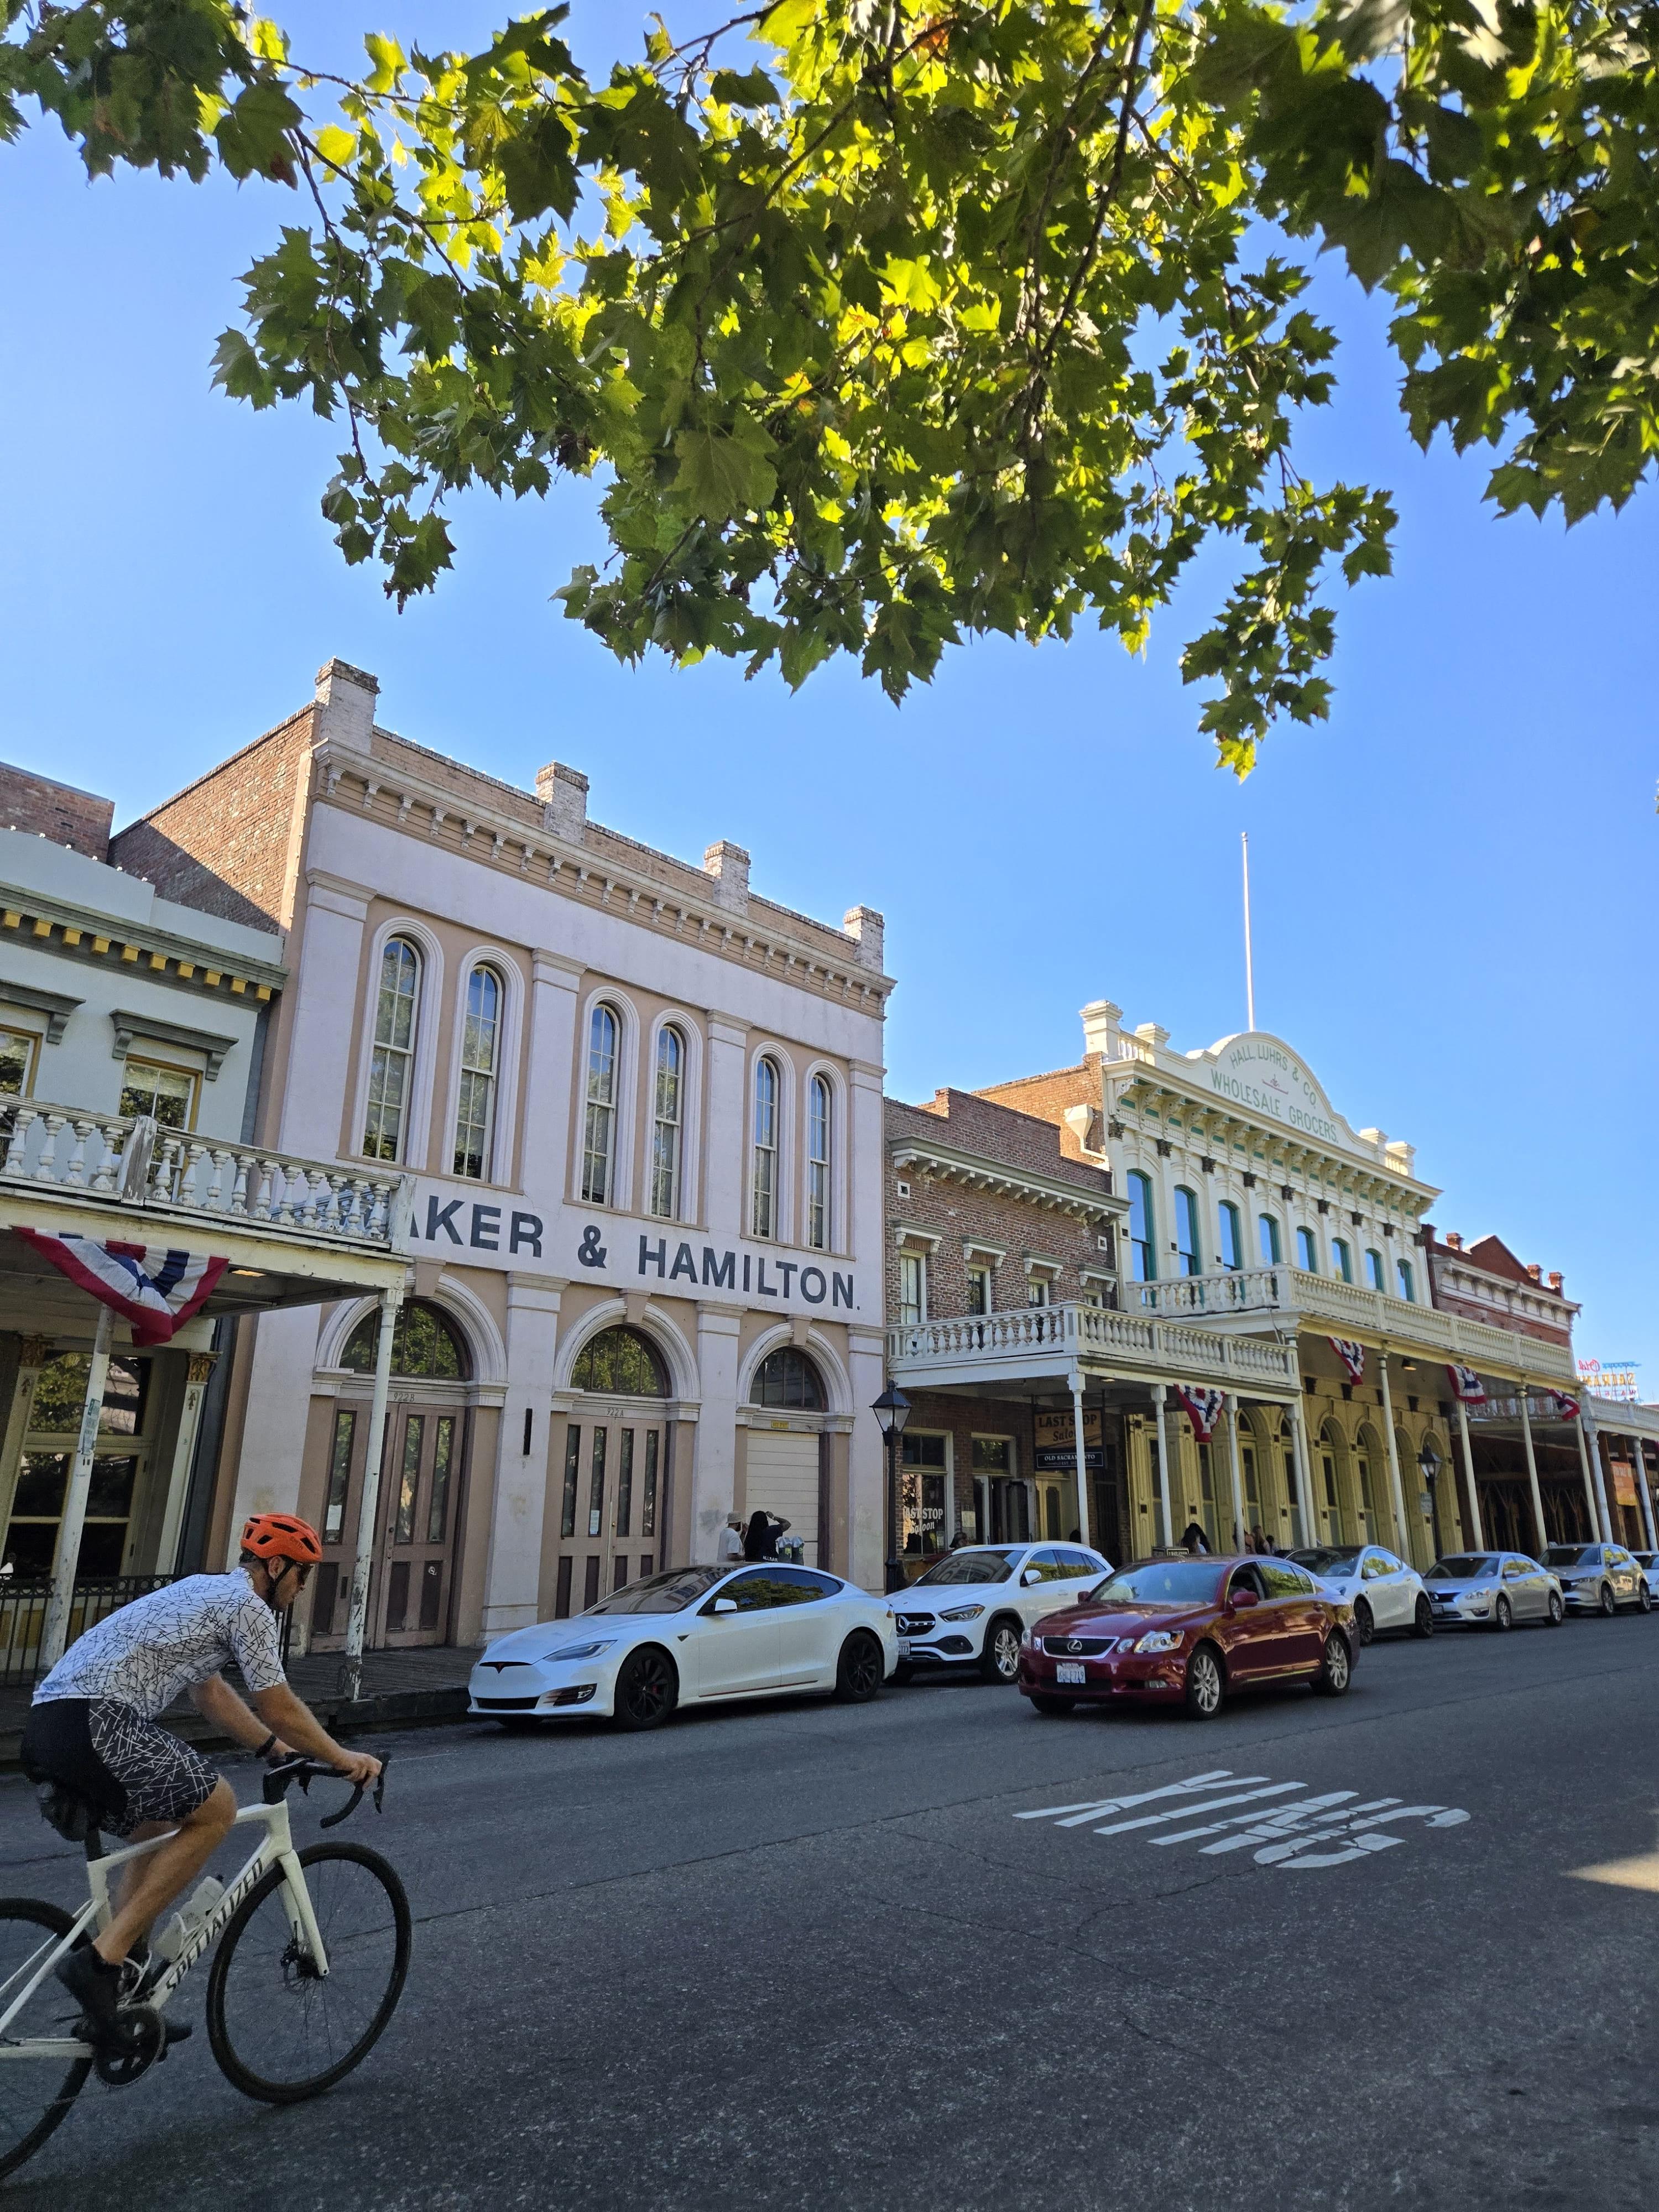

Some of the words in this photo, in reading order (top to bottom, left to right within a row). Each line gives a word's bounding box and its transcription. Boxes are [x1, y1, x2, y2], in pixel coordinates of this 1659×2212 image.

[1258, 1044, 1288, 1071] LUHRS
[1292, 1067, 1299, 1083] &
[1211, 1068, 1281, 1118] WHOLESALE
[410, 1195, 543, 1258] KER
[578, 1225, 607, 1269] &
[638, 1235, 860, 1310] HAMILTON.
[1039, 1416, 1066, 1427] LAST
[1068, 1414, 1097, 1426] SOP
[922, 1507, 943, 1520] STOP
[910, 1521, 935, 1535] Saloon
